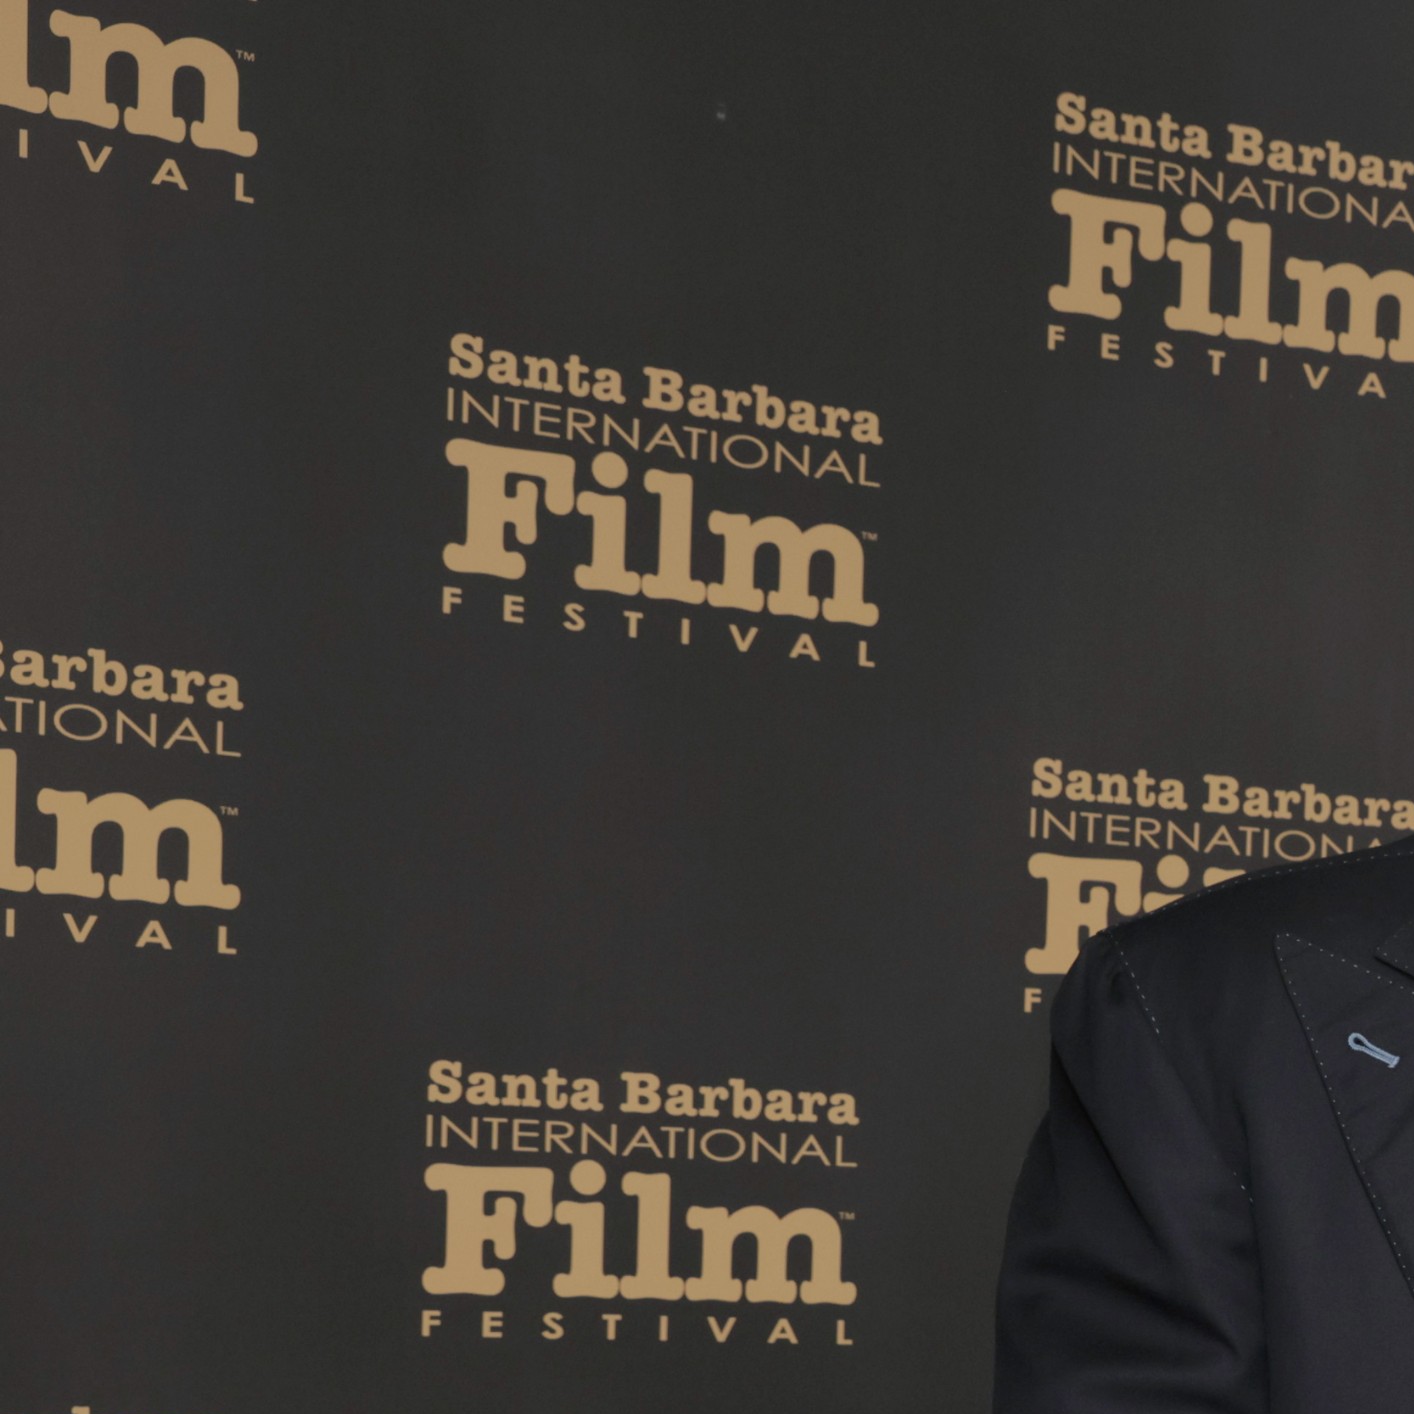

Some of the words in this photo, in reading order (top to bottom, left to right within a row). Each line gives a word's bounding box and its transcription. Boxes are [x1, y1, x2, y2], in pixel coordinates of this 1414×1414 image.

[0, 0, 258, 157] lm
[1055, 92, 1211, 158] Santa
[19, 129, 254, 203] IVAL
[449, 333, 625, 403] Santa
[642, 367, 883, 445] Barbara
[448, 389, 880, 487] INTERNATIONAL
[443, 438, 879, 626] Film
[443, 587, 875, 667] FESTIVAL
[0, 641, 244, 710] arbara
[1032, 758, 1188, 810] Santa
[1029, 807, 1383, 862] INTERNATION
[6, 908, 237, 954] IVAL
[427, 1060, 604, 1111] Santa
[620, 1072, 860, 1125] Barbara
[426, 1115, 856, 1167] INTERNATIONAL
[422, 1160, 857, 1305] Film
[421, 1310, 853, 1345] FESTIVAL
